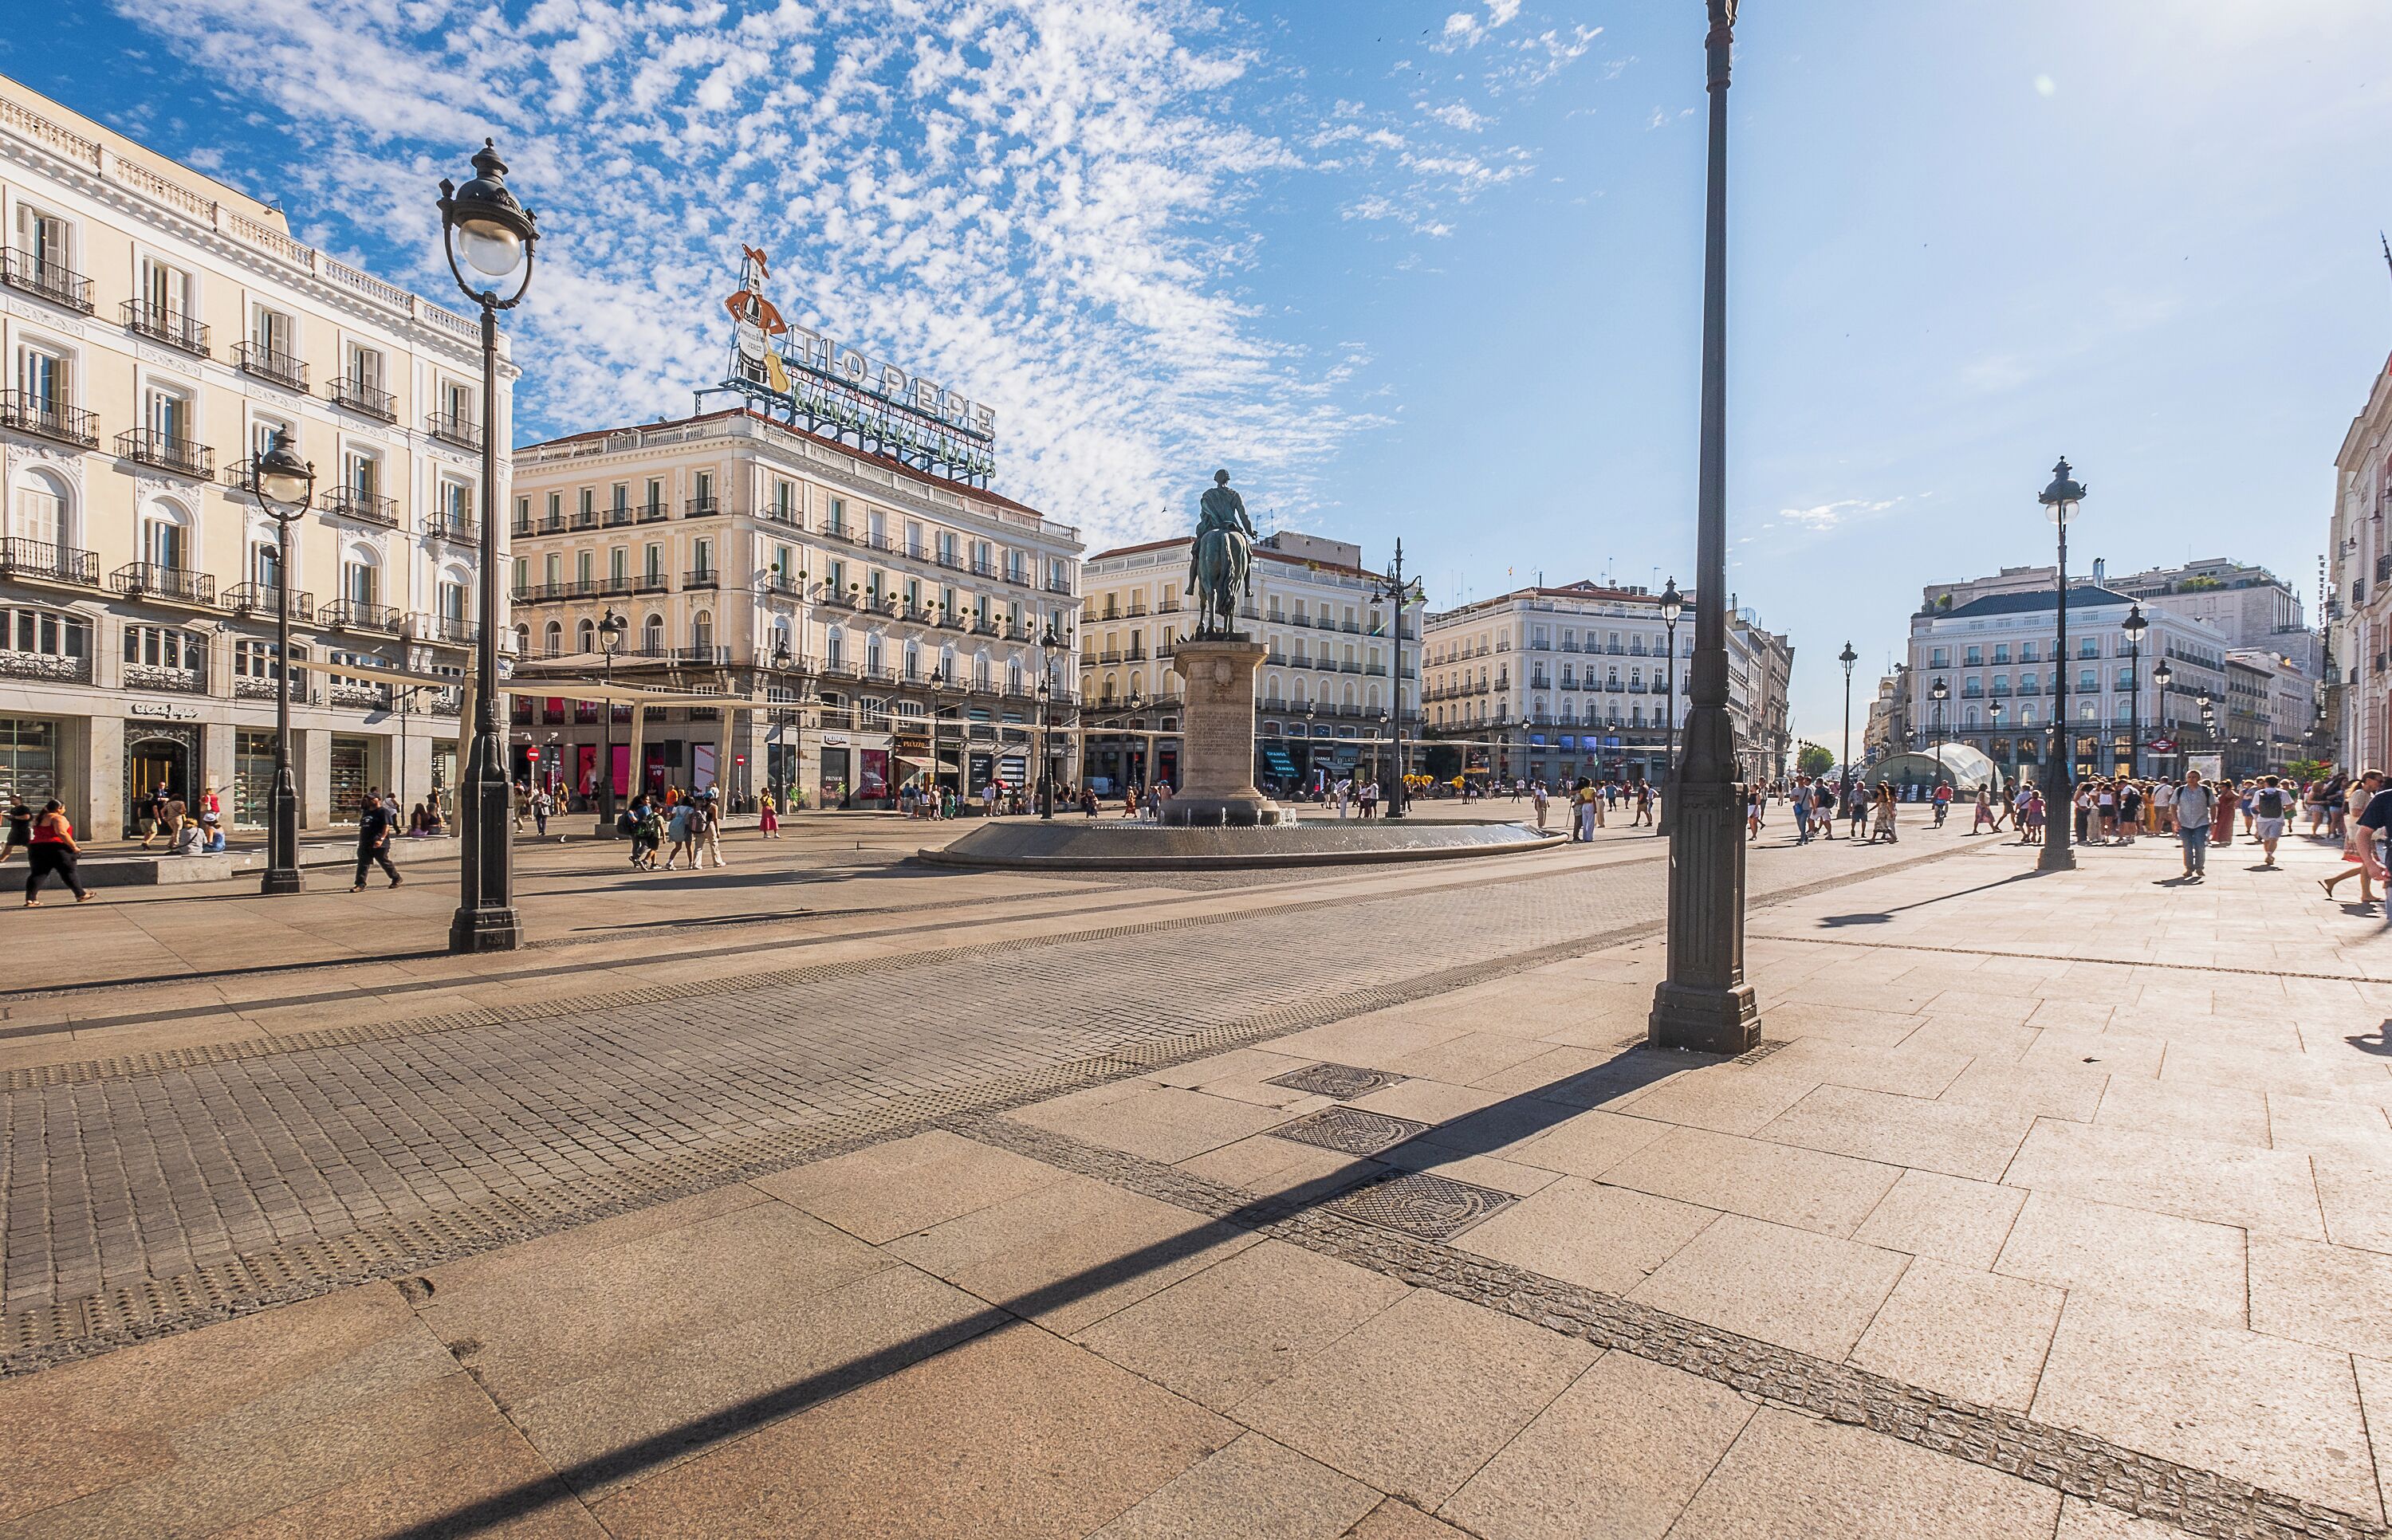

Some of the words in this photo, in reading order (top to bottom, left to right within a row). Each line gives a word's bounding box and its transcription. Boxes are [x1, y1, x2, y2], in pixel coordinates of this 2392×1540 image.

[793, 324, 867, 383] TIO
[884, 363, 996, 438] PEPE
[938, 434, 996, 479] BYASS
[825, 733, 847, 743] PRIMOR
